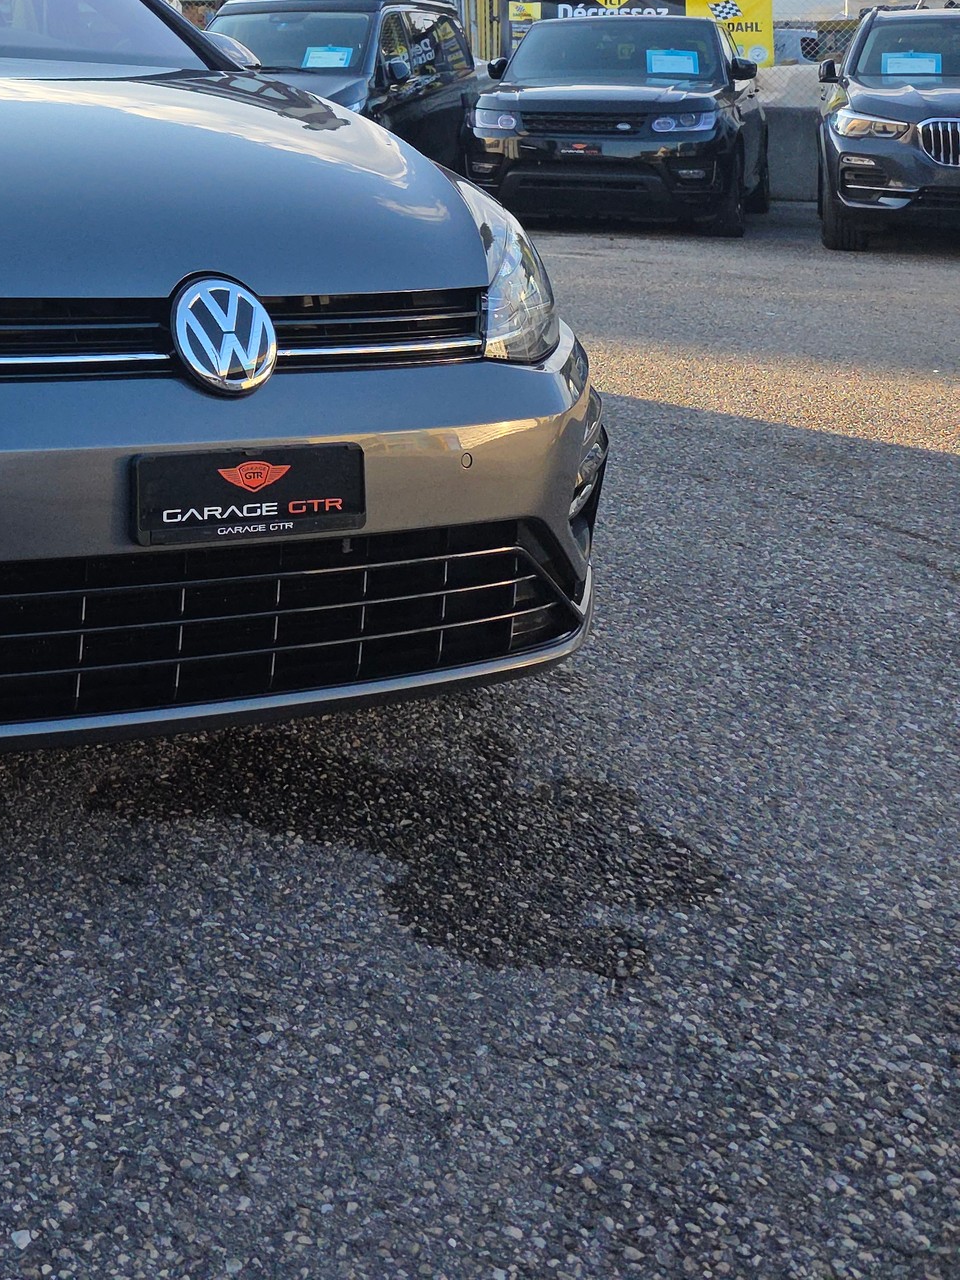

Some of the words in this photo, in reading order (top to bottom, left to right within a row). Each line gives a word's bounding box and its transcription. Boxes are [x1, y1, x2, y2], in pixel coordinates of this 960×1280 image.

[245, 471, 263, 480] GTR
[163, 502, 278, 523] GARAGE
[288, 498, 343, 514] GTR
[217, 524, 266, 535] GARAGE
[270, 521, 294, 531] GTR
